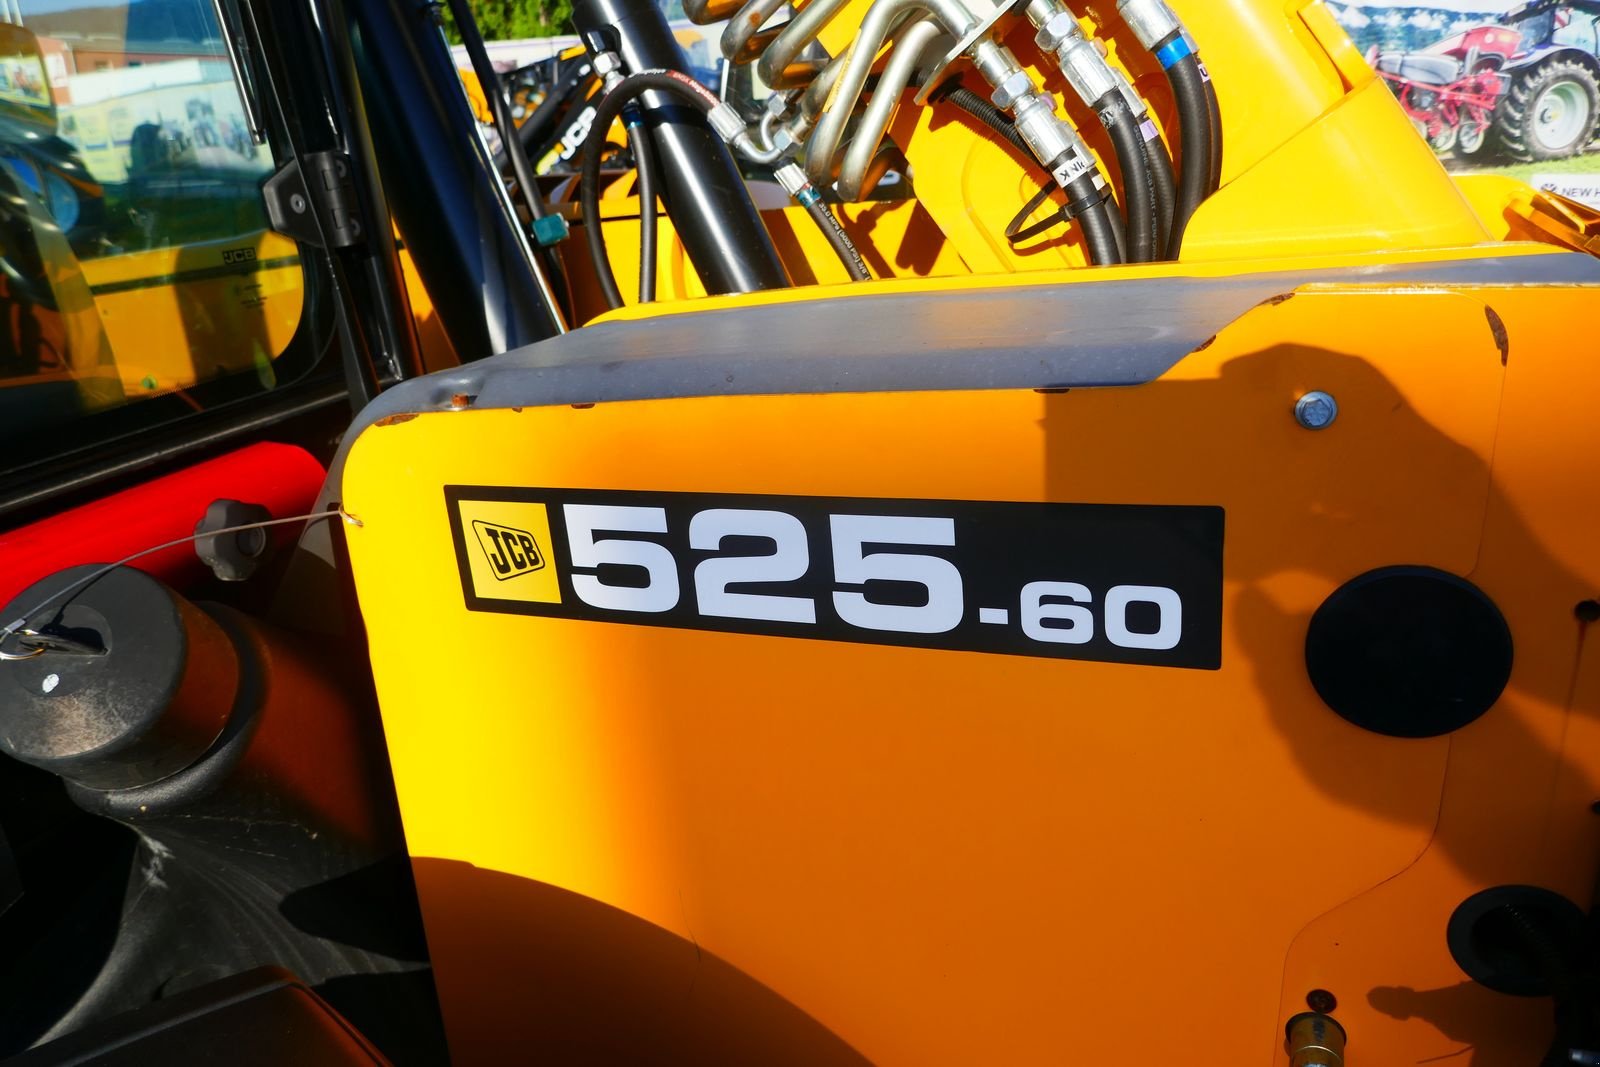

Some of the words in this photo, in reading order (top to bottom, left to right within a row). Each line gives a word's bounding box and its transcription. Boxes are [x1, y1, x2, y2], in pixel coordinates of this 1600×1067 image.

[1562, 187, 1592, 197] NEW
[224, 249, 254, 263] JCB
[485, 527, 540, 574] JCB
